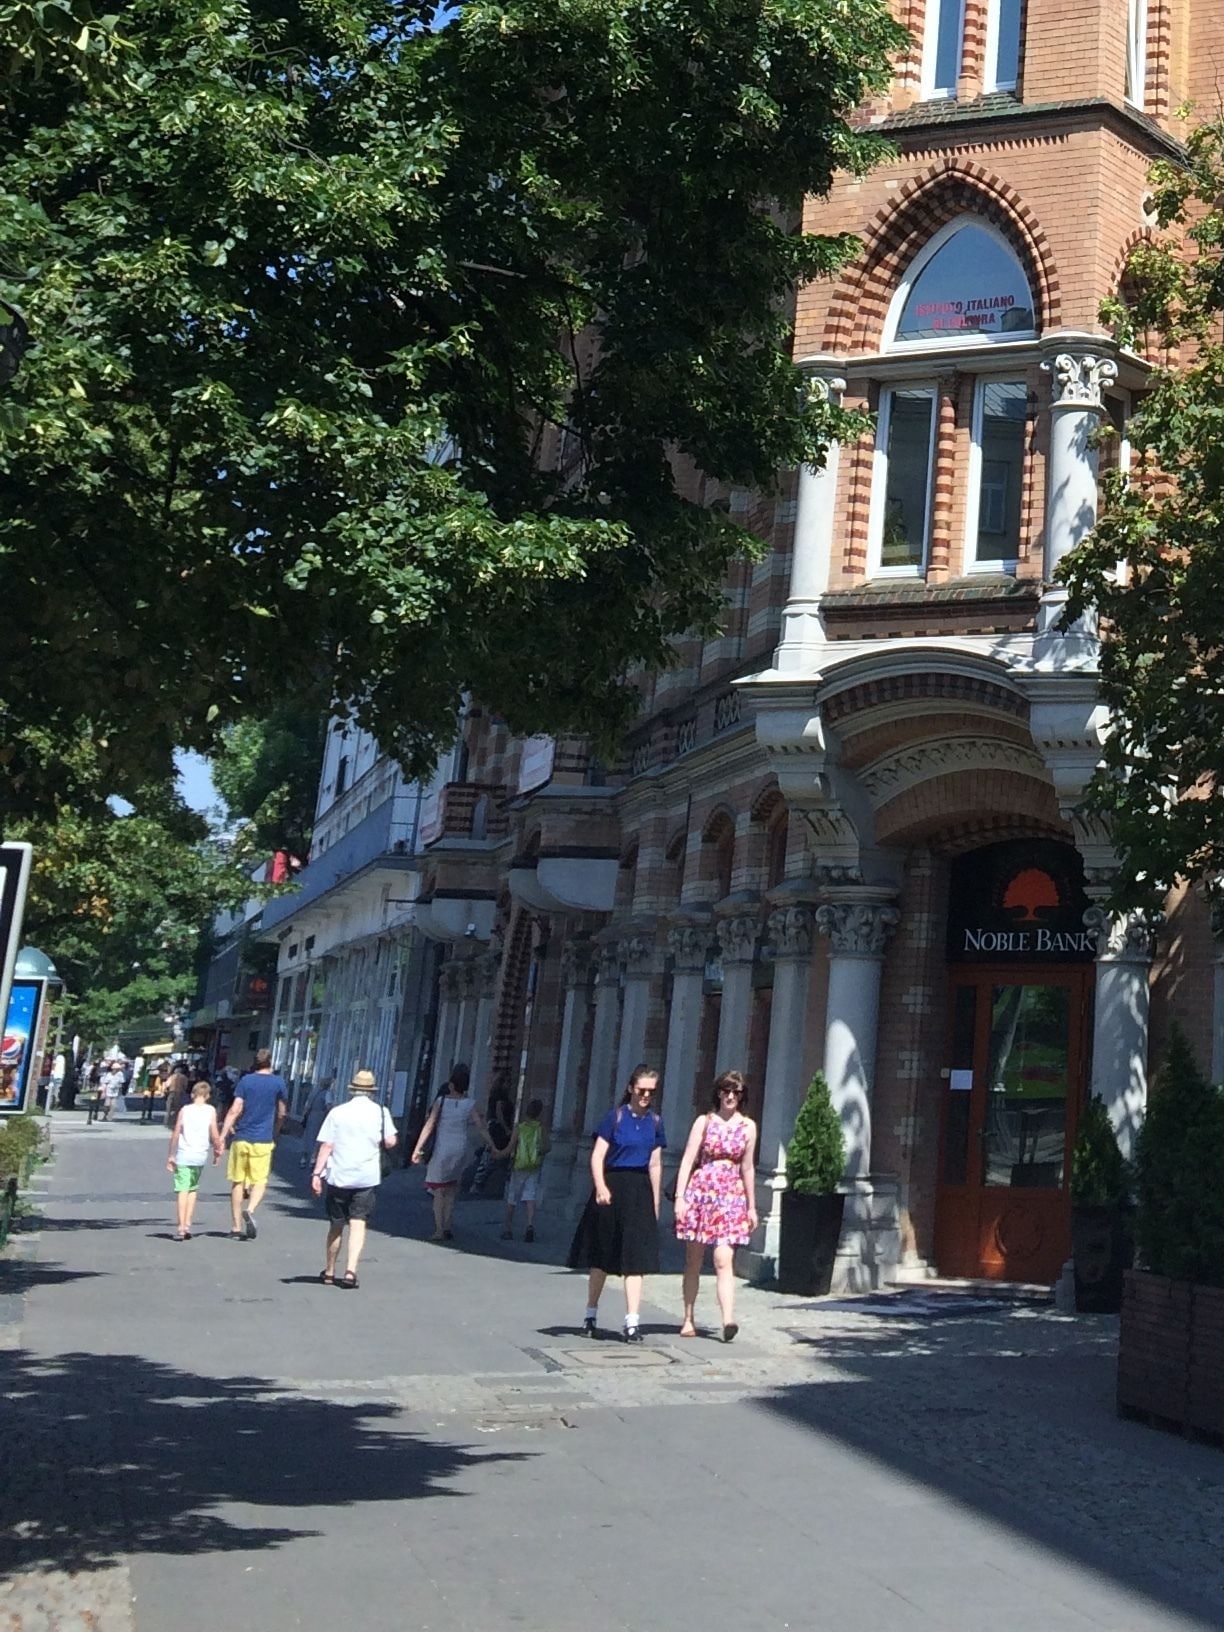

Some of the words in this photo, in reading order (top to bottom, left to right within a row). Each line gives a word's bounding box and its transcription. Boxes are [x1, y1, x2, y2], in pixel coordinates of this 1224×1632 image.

[967, 295, 1015, 311] ITALIANO
[963, 928, 1031, 952] NOBLE
[1034, 928, 1096, 952] BANK
